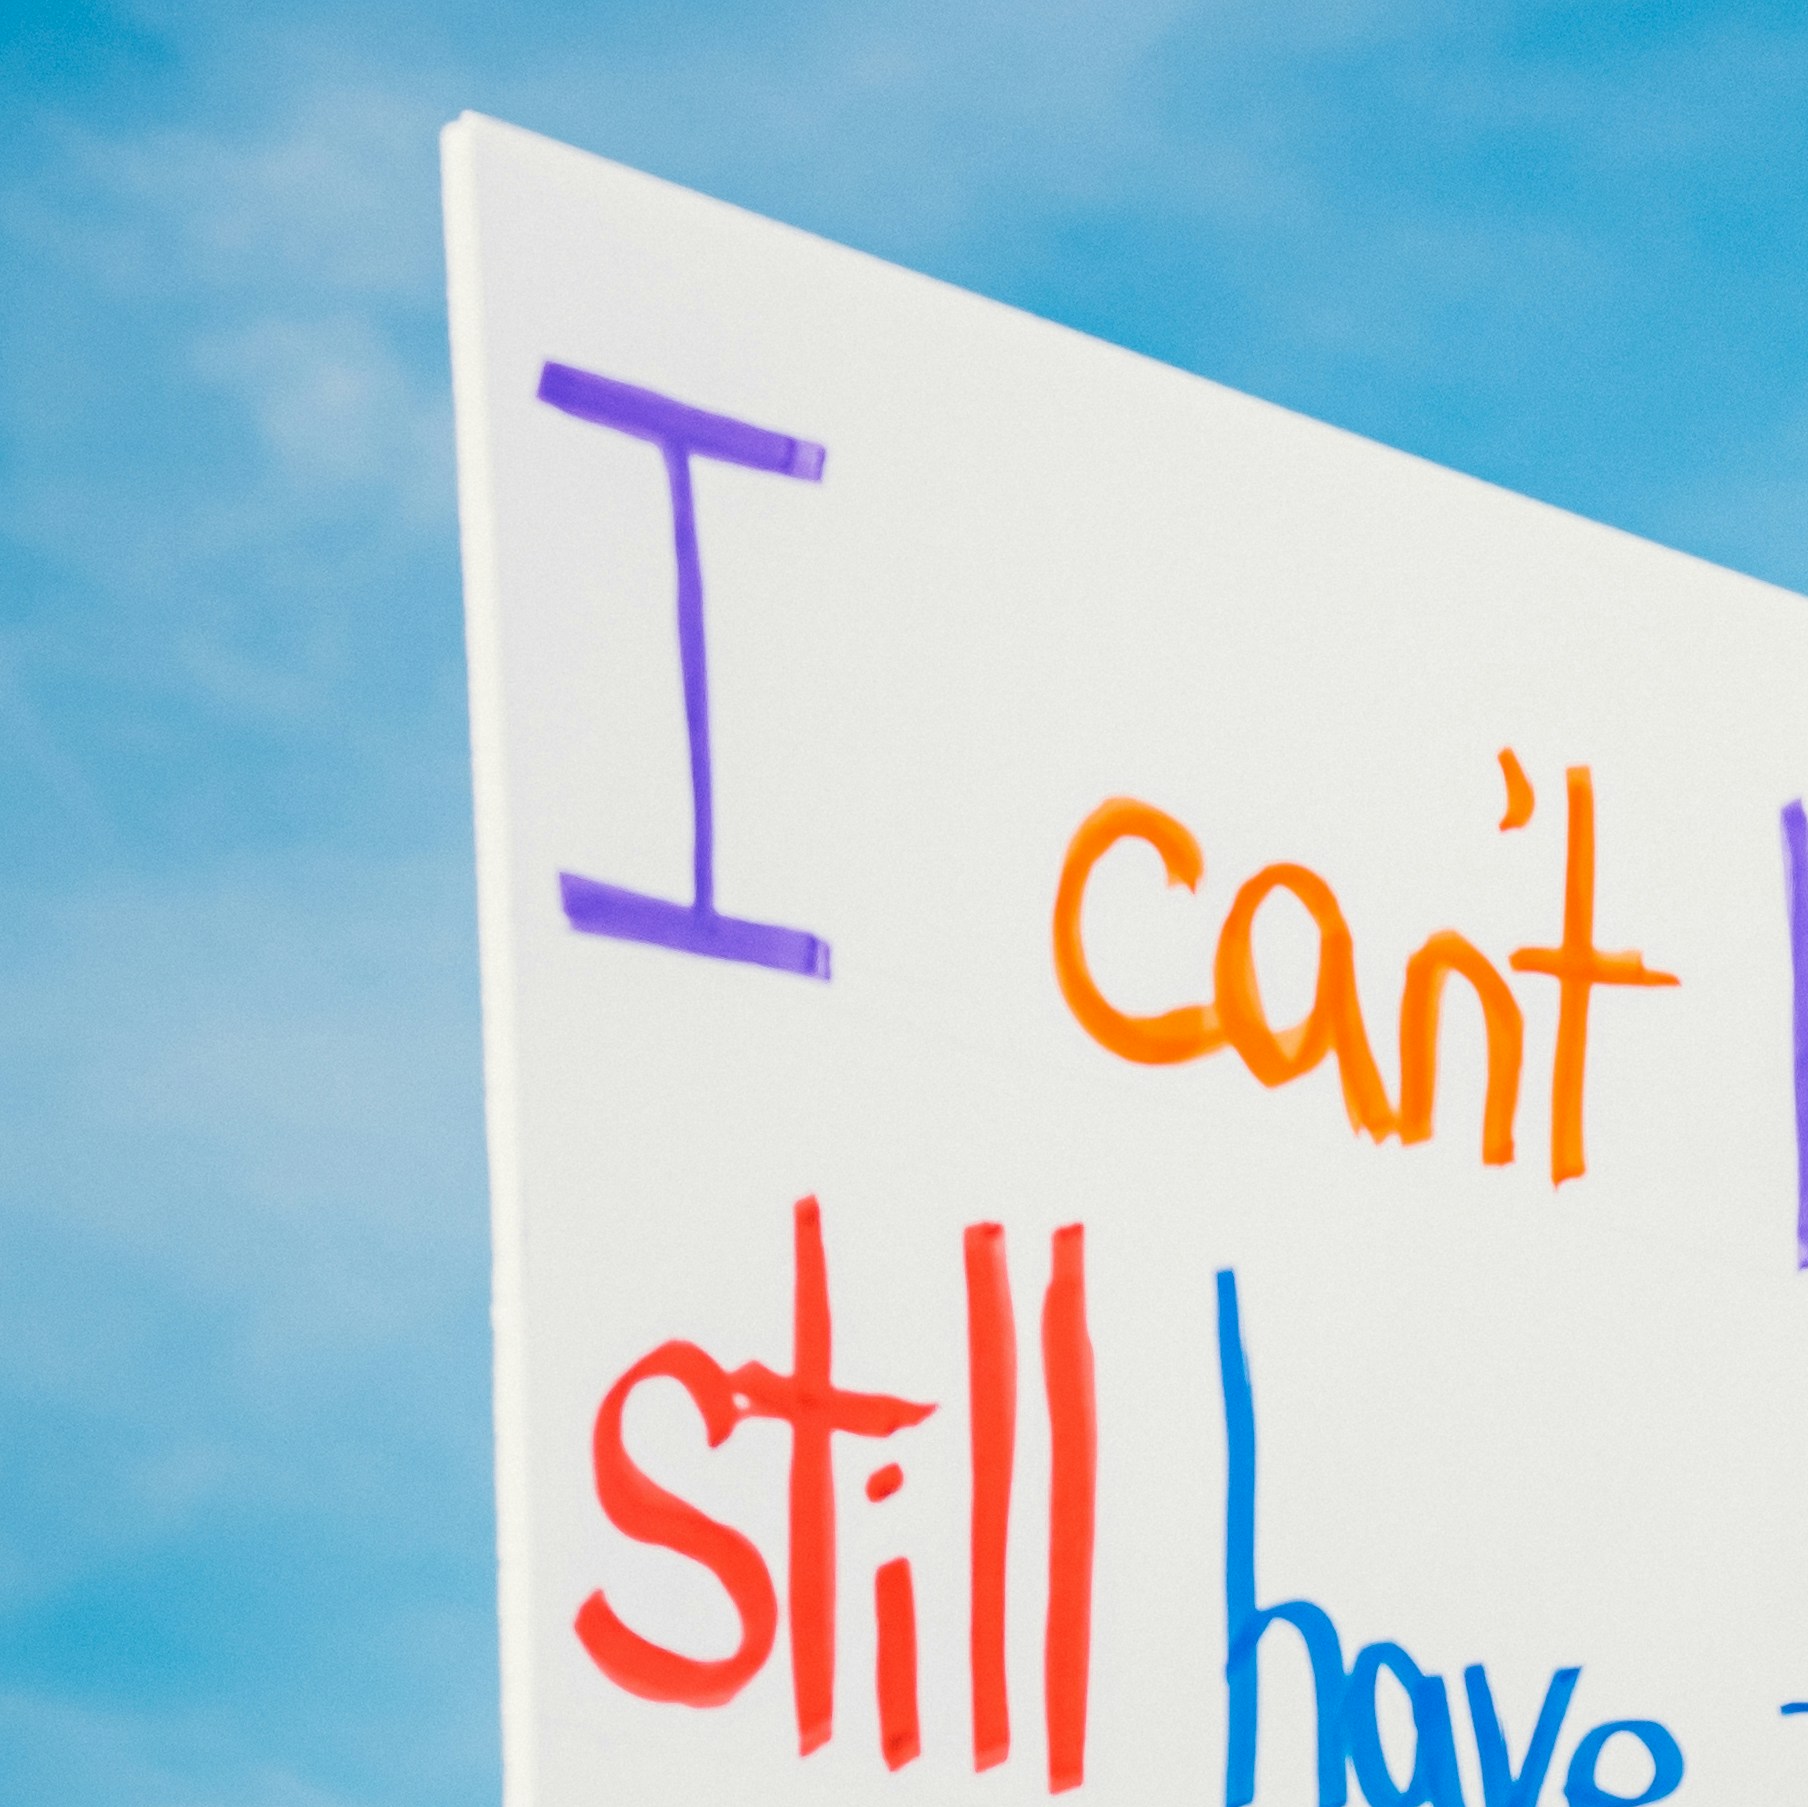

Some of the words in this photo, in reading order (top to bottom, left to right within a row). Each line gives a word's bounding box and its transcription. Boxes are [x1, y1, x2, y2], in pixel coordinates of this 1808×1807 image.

[537, 361, 831, 980] I
[1051, 746, 1680, 1189] can't
[573, 1195, 1098, 1796] still
